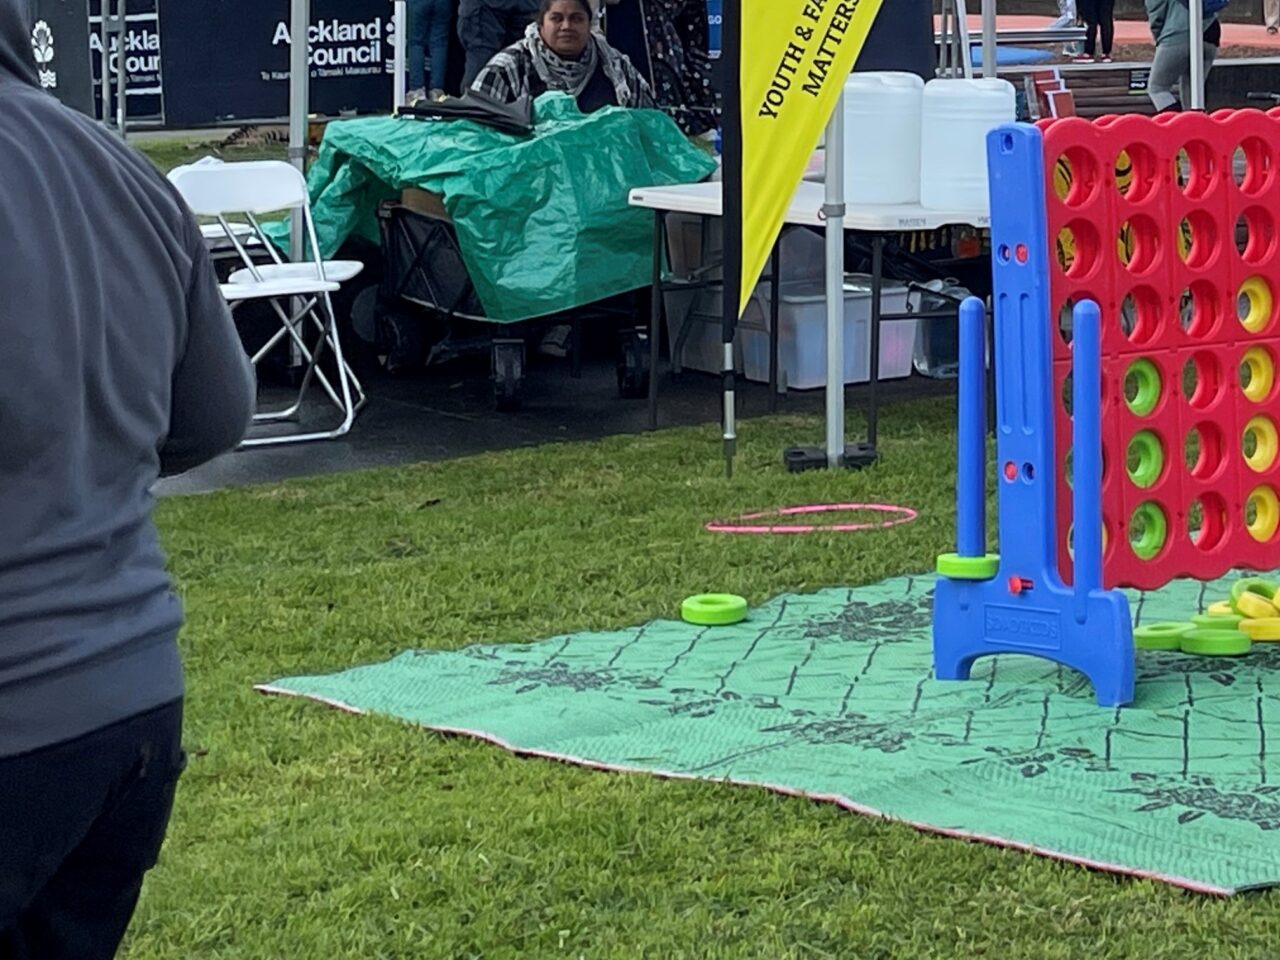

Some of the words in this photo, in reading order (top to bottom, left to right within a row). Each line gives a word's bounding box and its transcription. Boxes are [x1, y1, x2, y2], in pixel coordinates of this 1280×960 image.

[272, 17, 381, 45] Ackland
[758, 41, 806, 119] YOUTH
[794, 25, 815, 41] &
